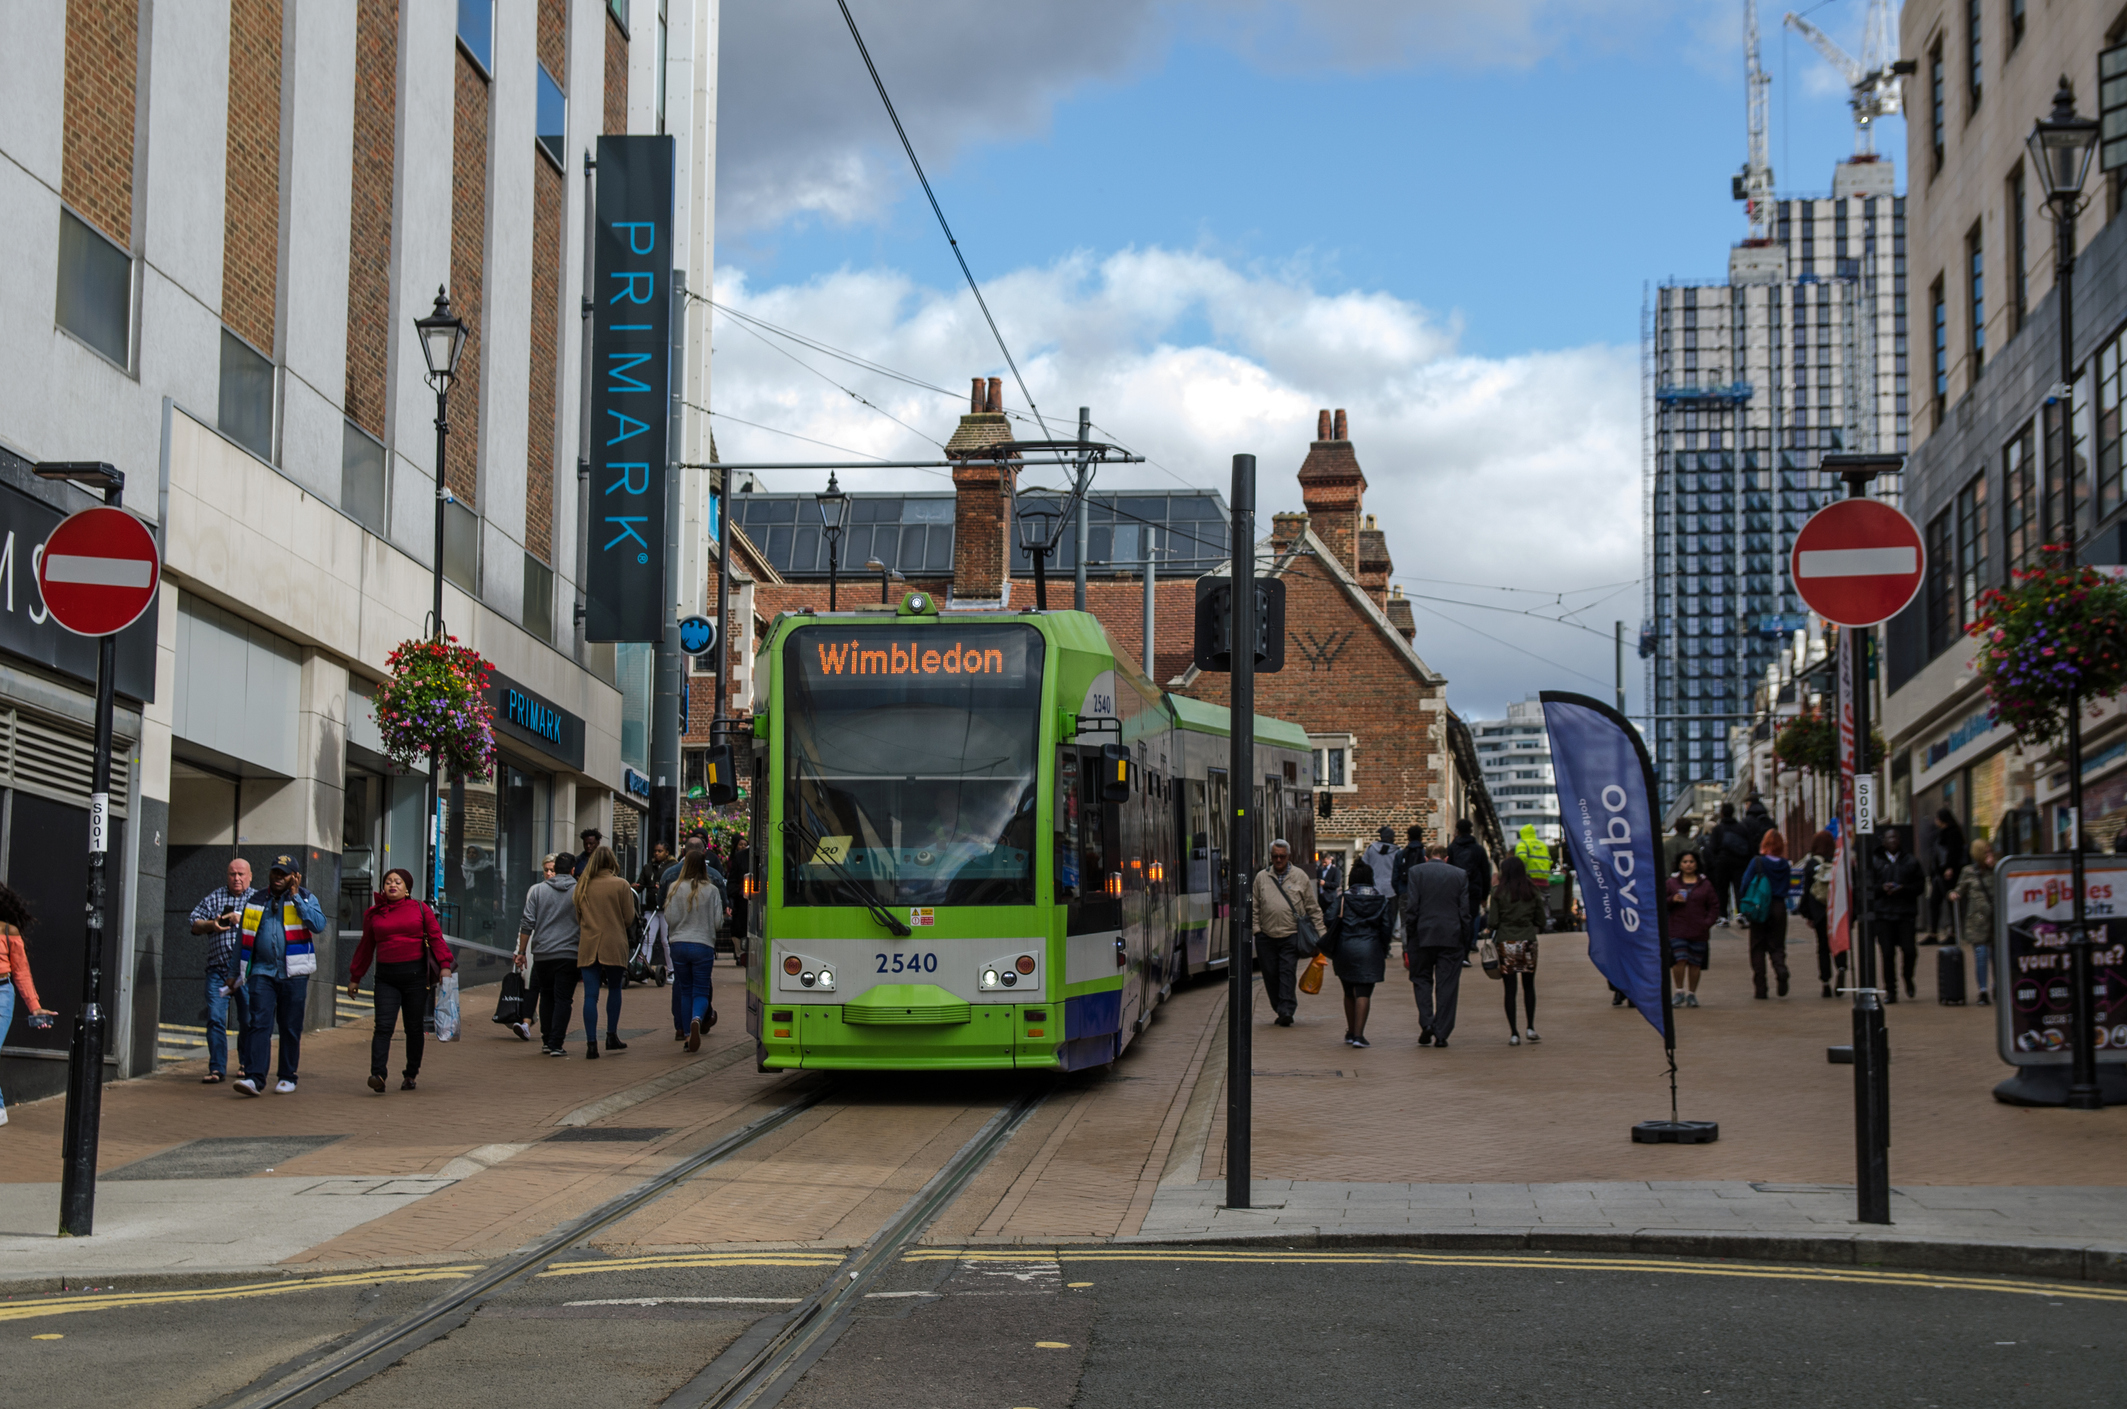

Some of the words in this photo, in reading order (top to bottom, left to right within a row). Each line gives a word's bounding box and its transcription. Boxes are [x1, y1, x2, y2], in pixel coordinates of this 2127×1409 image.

[604, 222, 655, 552] PRIMARK
[818, 639, 1003, 675] Wimbledon
[509, 689, 561, 744] PRIMARK
[1094, 694, 1111, 714] 2540
[93, 803, 102, 848] S001
[1859, 784, 1870, 830] S002
[875, 953, 938, 973] 2540
